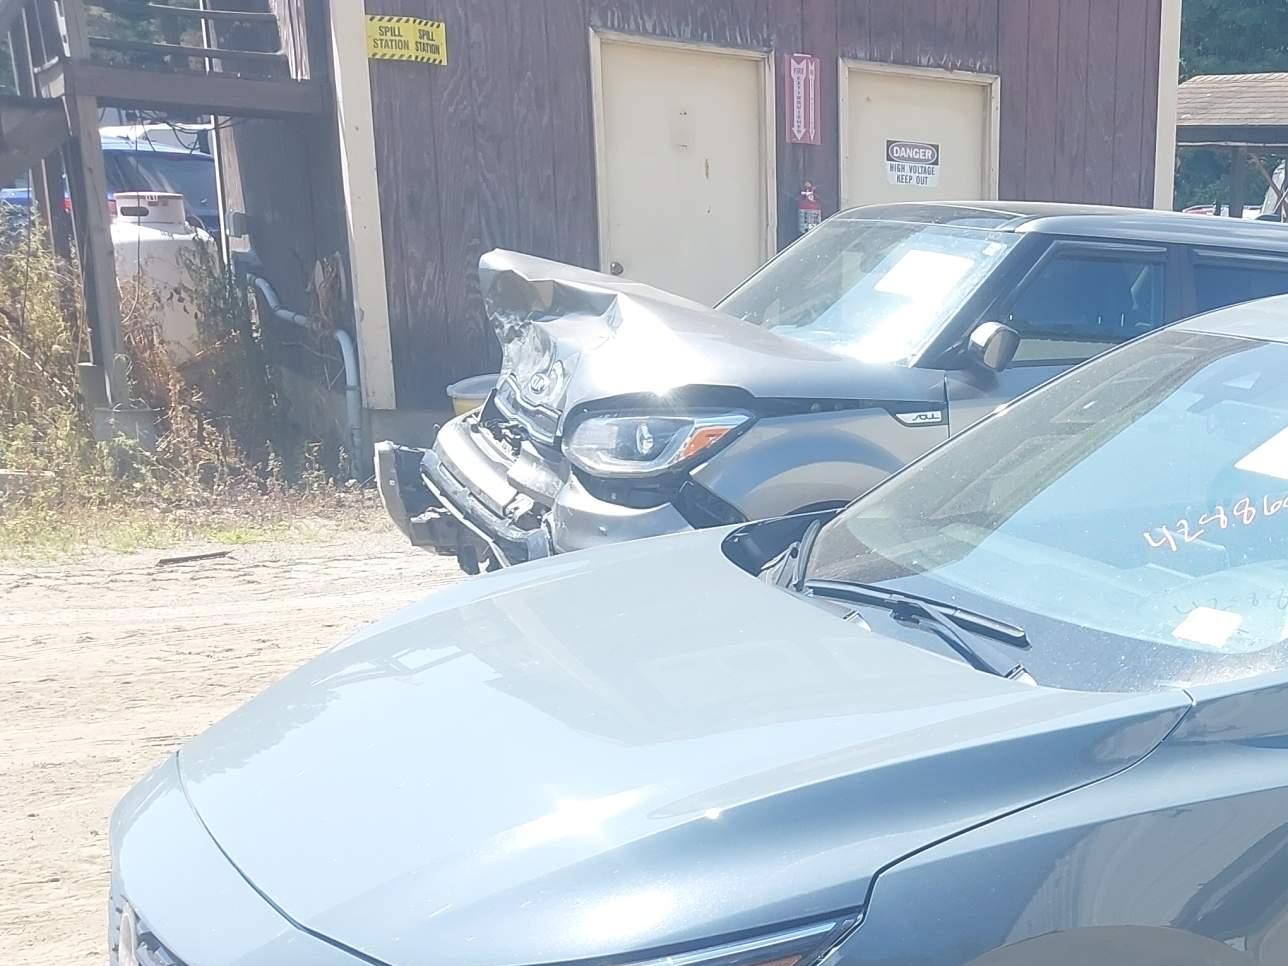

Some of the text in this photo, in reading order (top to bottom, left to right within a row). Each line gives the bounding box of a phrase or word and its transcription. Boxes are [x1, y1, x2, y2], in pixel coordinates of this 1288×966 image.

[378, 25, 403, 37] SPILL
[418, 28, 435, 42] SPILL
[373, 38, 409, 50] STATION
[415, 41, 440, 55] STATION
[893, 146, 932, 160] DANGER
[890, 163, 936, 175] HIGH VOLTAGE
[897, 174, 928, 185] KEEP OUT
